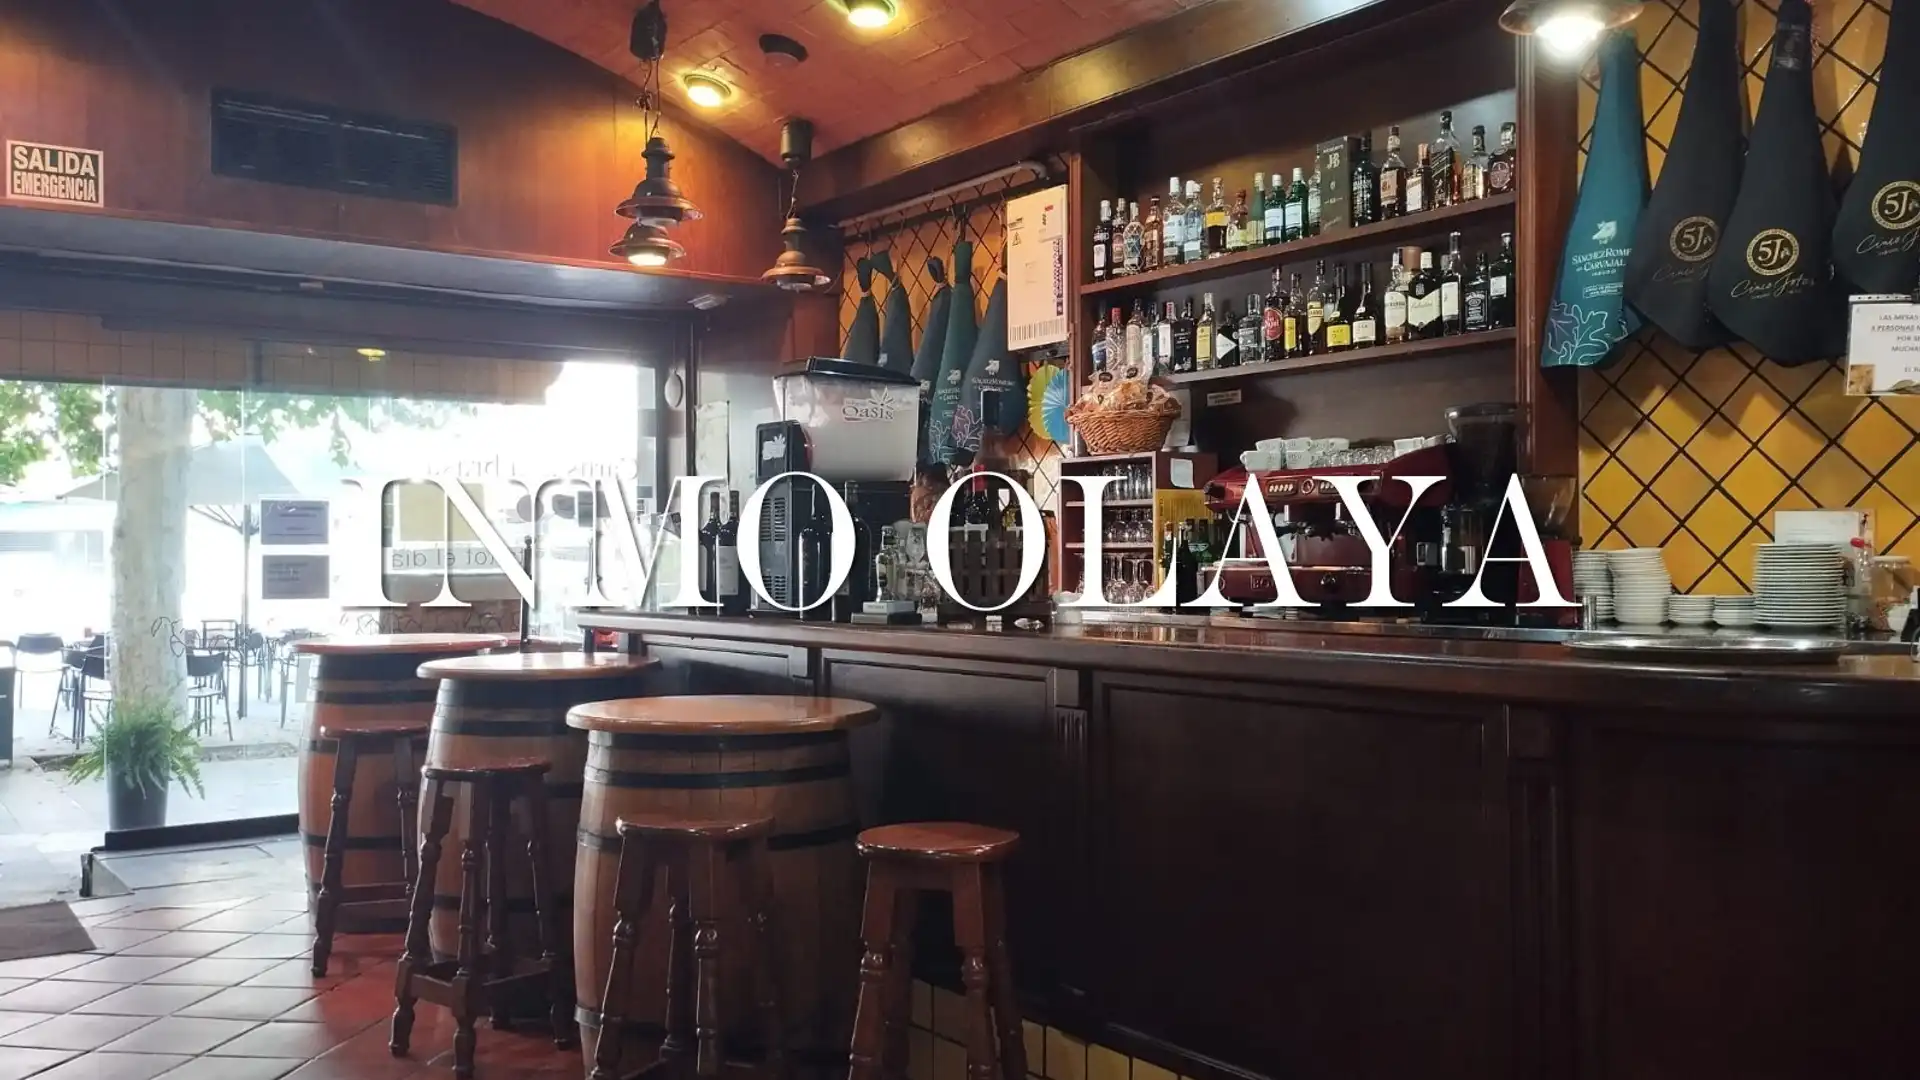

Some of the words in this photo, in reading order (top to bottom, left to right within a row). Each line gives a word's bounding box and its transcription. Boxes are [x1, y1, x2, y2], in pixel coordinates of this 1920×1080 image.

[14, 145, 96, 178] SALIDA
[13, 170, 97, 202] EMERGENCIA
[1877, 324, 1915, 332] PERSONAS
[842, 405, 894, 421] Oasis
